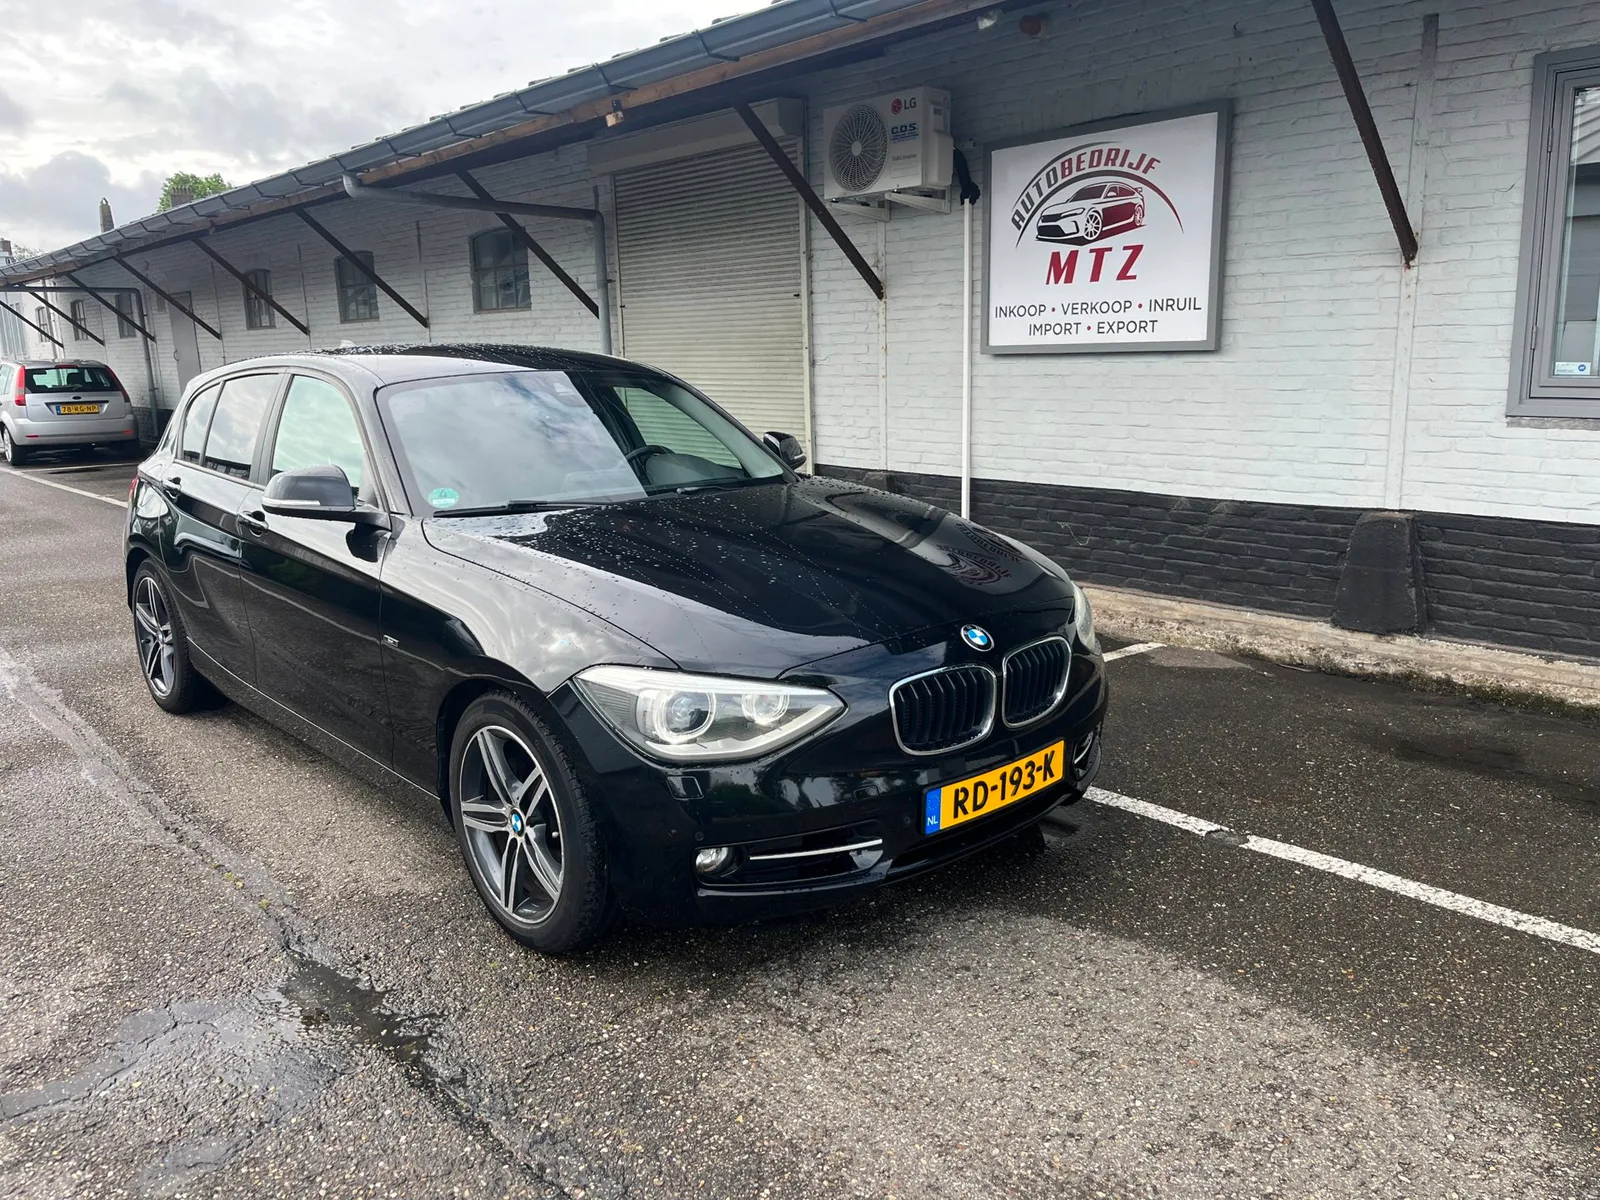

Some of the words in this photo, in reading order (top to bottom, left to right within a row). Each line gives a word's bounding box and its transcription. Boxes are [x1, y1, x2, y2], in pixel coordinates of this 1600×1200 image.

[904, 97, 916, 109] LG
[1010, 147, 1161, 231] AUTOBEDRIJF
[1045, 244, 1144, 285] MTZ
[995, 304, 1047, 318] INKOOP
[1061, 300, 1133, 316] VERKOOP
[1149, 297, 1202, 312] INRUIL
[1029, 322, 1082, 336] IMPORT
[1097, 320, 1158, 334] EXPORT
[953, 750, 1055, 819] RD-193-K
[927, 815, 938, 826] NL
